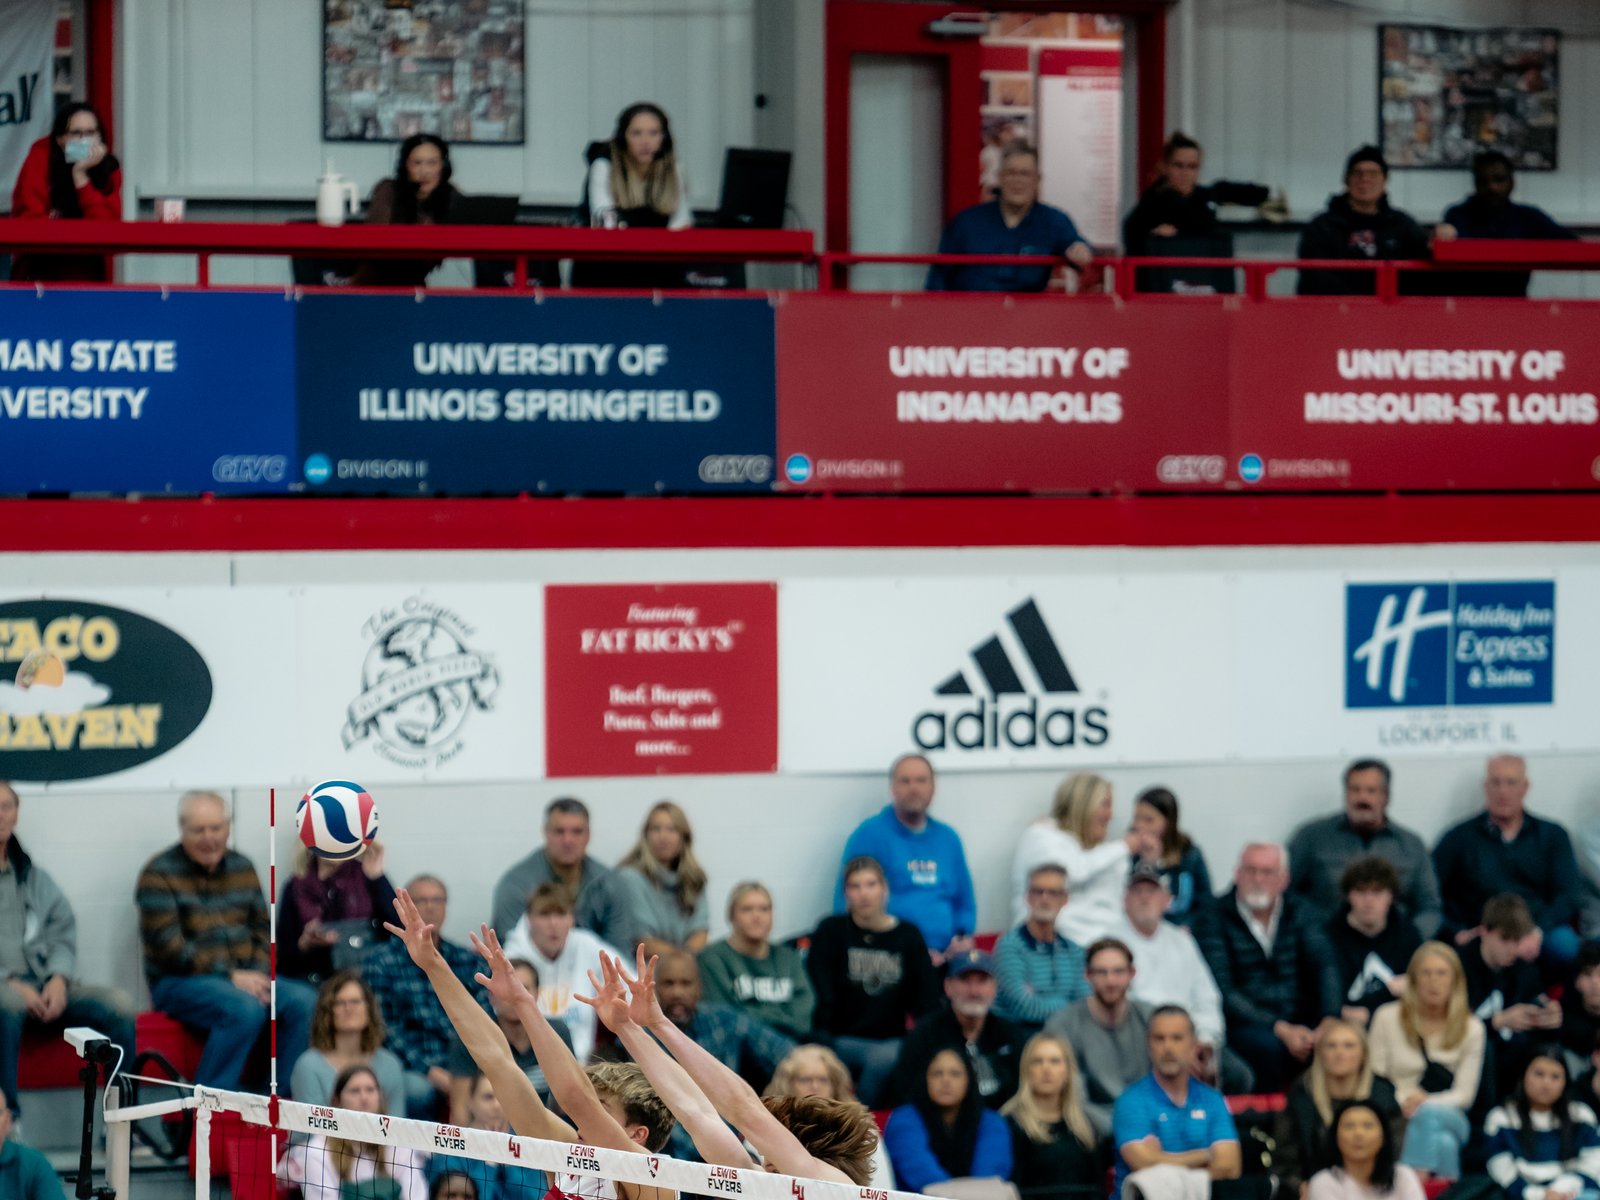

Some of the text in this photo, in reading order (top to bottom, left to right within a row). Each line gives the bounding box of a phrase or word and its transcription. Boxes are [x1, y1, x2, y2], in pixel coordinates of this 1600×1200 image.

[70, 340, 178, 373] STATE
[413, 343, 668, 375] UNIVERSITY OF
[889, 347, 1130, 377] UNIVERSITY OF
[1337, 350, 1565, 380] UNIVERSITY OF
[0, 386, 150, 420] VERSITY
[359, 388, 721, 422] ILLINOIS SPRINGFIELD
[897, 391, 1122, 423] INDIANAPOLIS
[1304, 392, 1598, 424] MISSOURI-ST. LOUIS
[338, 458, 414, 479] DIVISION
[817, 459, 886, 479] DIVISION
[627, 602, 699, 626] Featuring
[1456, 601, 1554, 632] Holiday Inn
[580, 628, 631, 654] FAT
[1456, 630, 1549, 666] Express
[1486, 665, 1535, 688] Suites
[0, 704, 162, 751] AVEN
[689, 707, 723, 730] and
[912, 692, 1110, 751] adidas
[308, 1117, 338, 1131] FLYERS
[311, 1106, 334, 1118] LEWIS
[436, 1124, 461, 1137] LEWIS
[434, 1135, 465, 1151] FLYERS
[569, 1145, 595, 1158] LEWIS
[566, 1156, 600, 1172] FLYERS
[710, 1166, 738, 1180] LEWIS
[708, 1177, 742, 1194] FLYERS
[860, 1187, 888, 1200] LEWIS
